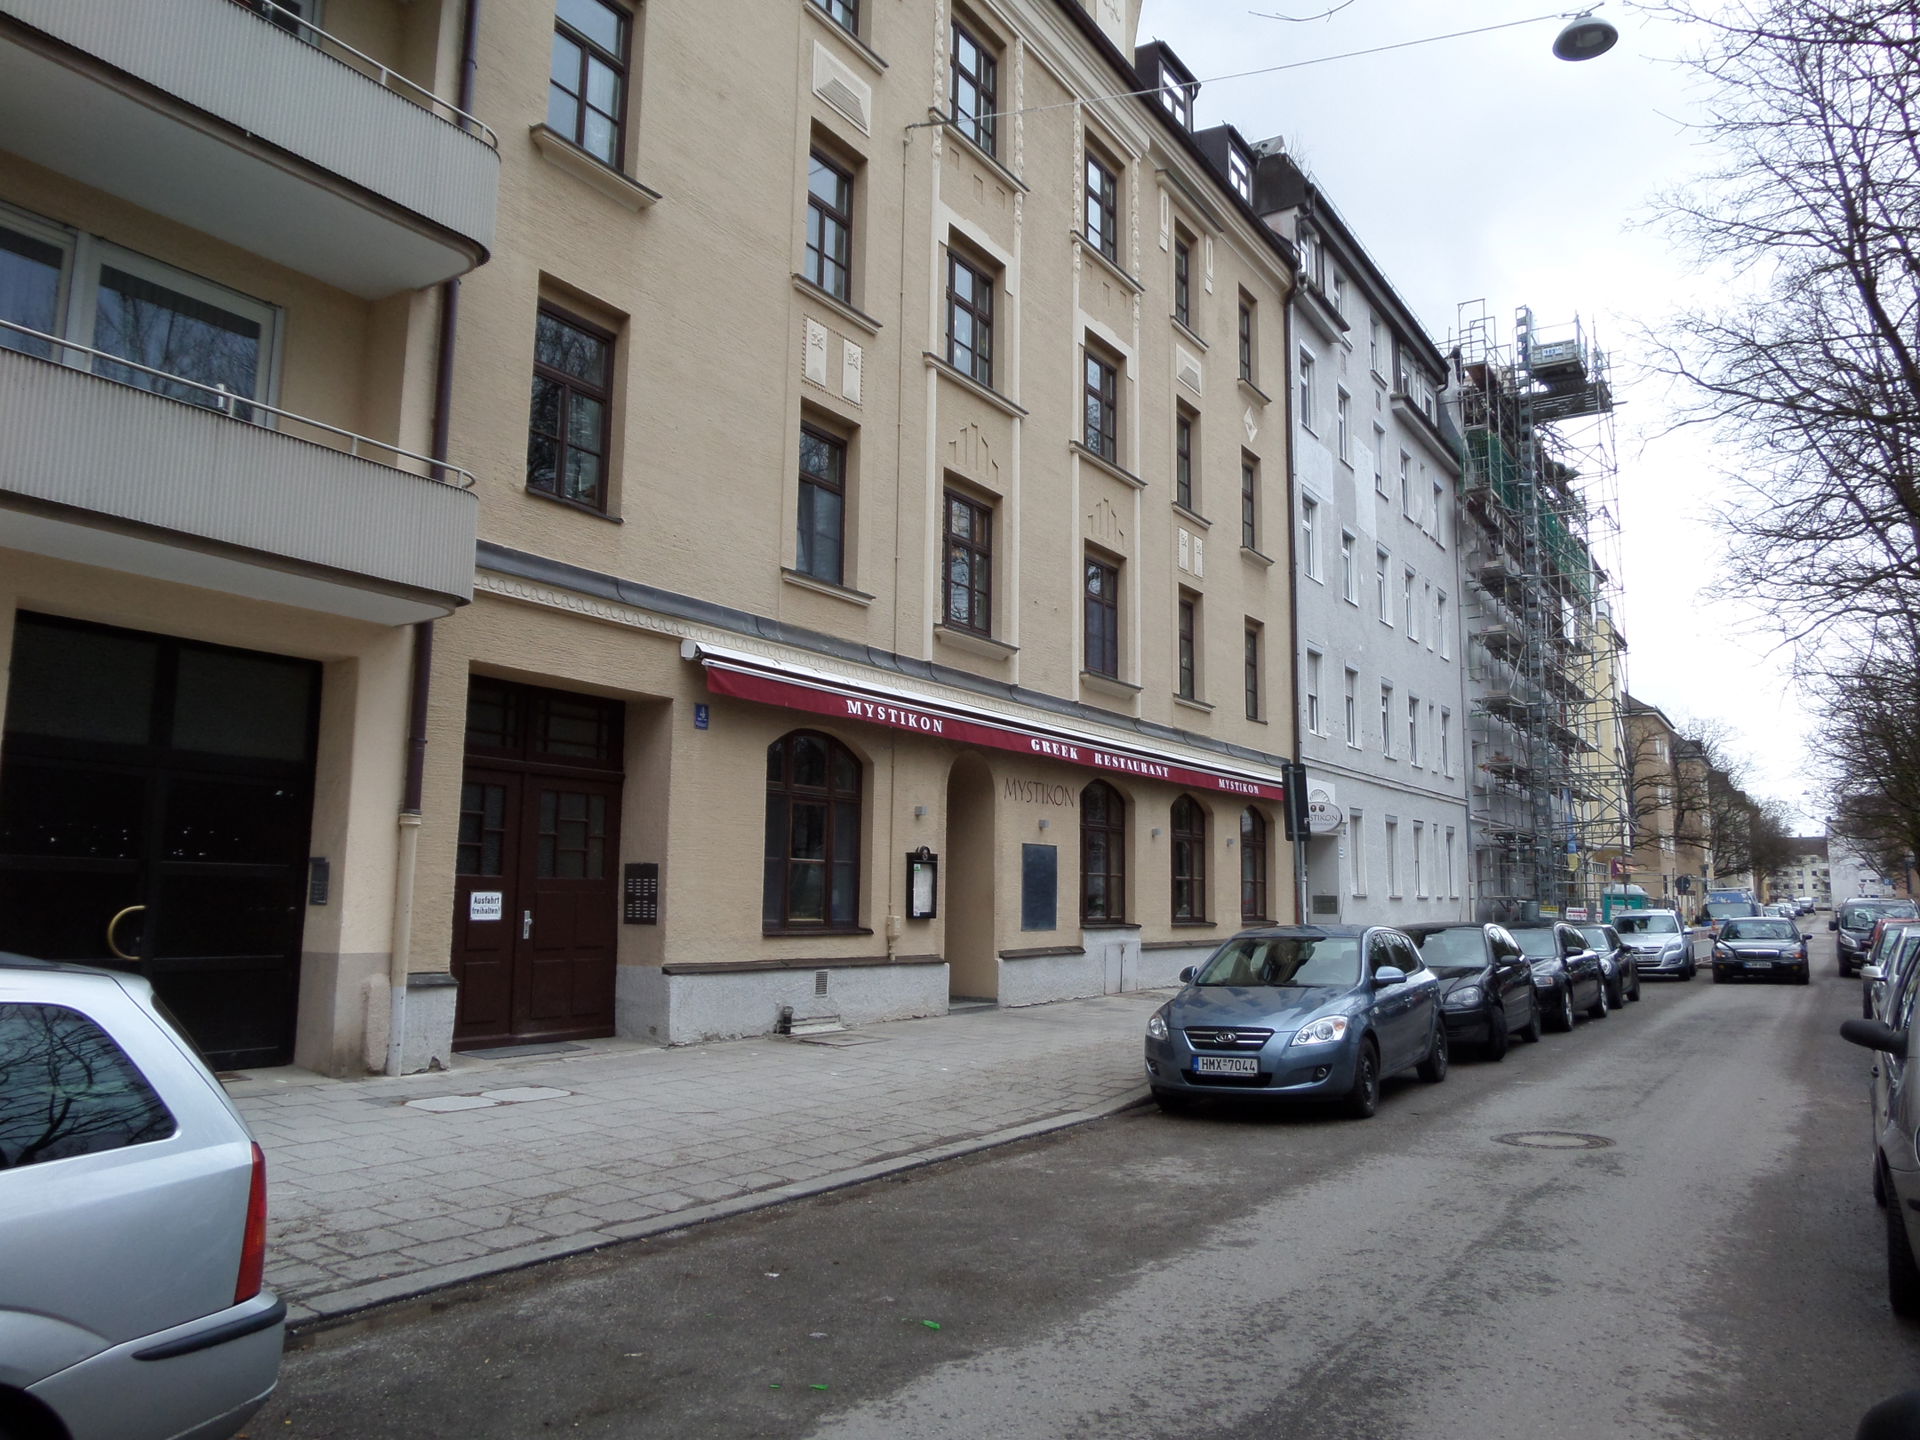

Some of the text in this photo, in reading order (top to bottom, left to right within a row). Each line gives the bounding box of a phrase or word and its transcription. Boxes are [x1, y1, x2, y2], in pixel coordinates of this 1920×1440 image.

[846, 699, 943, 733] MYSTIKON
[1030, 738, 1169, 777] GREEK RESTAURANT
[1003, 776, 1075, 808] MYSTIKON
[1218, 778, 1259, 795] MYSTIKON
[1309, 814, 1338, 822] STIKON
[473, 896, 499, 904] Ausfahrt
